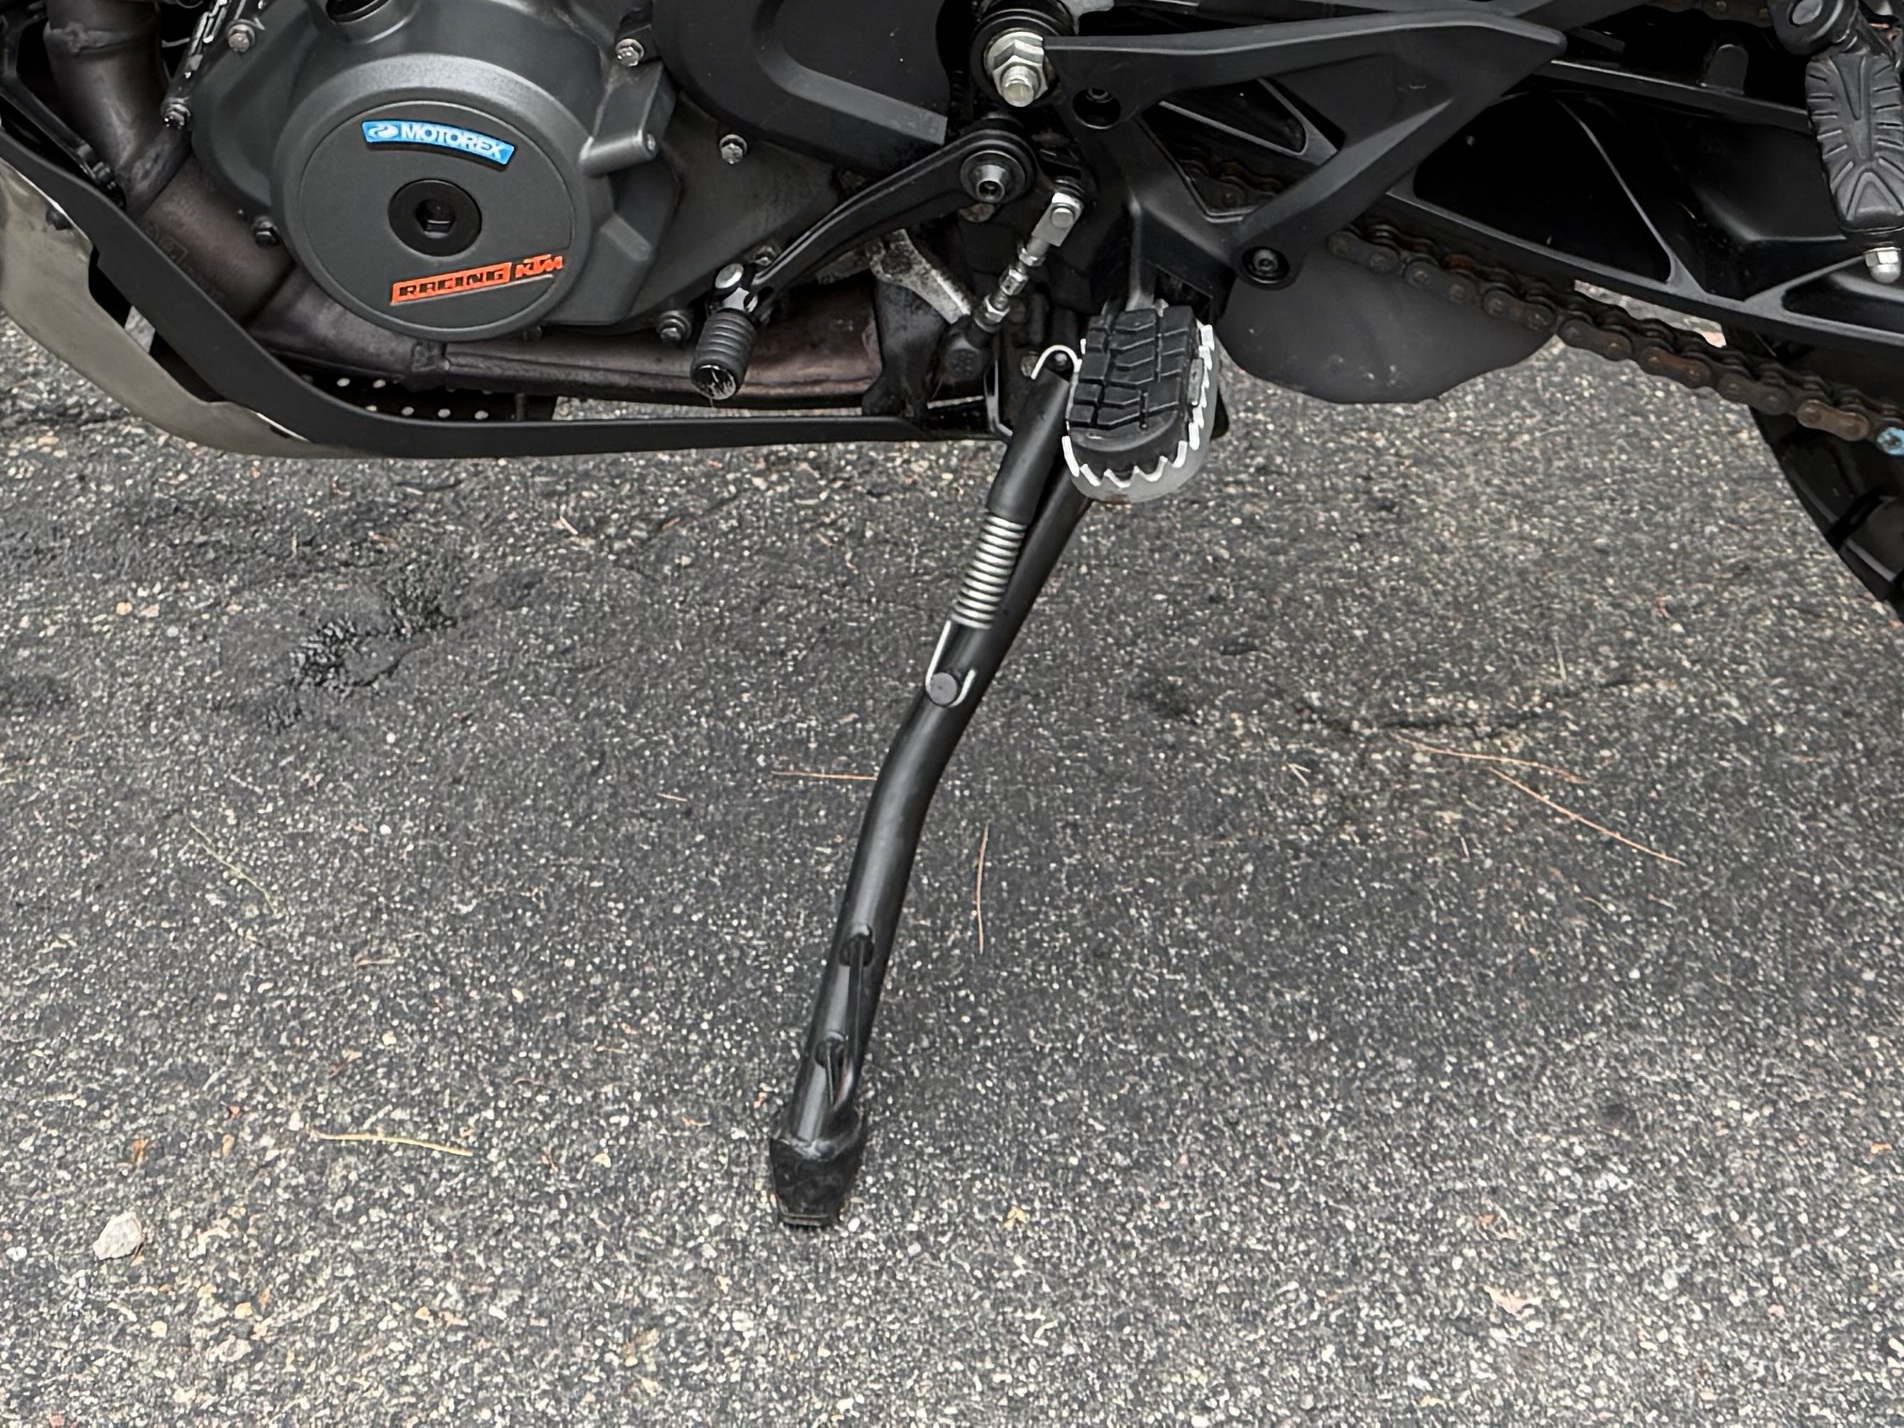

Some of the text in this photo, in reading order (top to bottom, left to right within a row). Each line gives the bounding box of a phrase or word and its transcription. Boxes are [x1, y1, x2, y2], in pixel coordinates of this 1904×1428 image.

[400, 121, 506, 160] MOTOREX
[398, 253, 563, 297] RACING KTM
